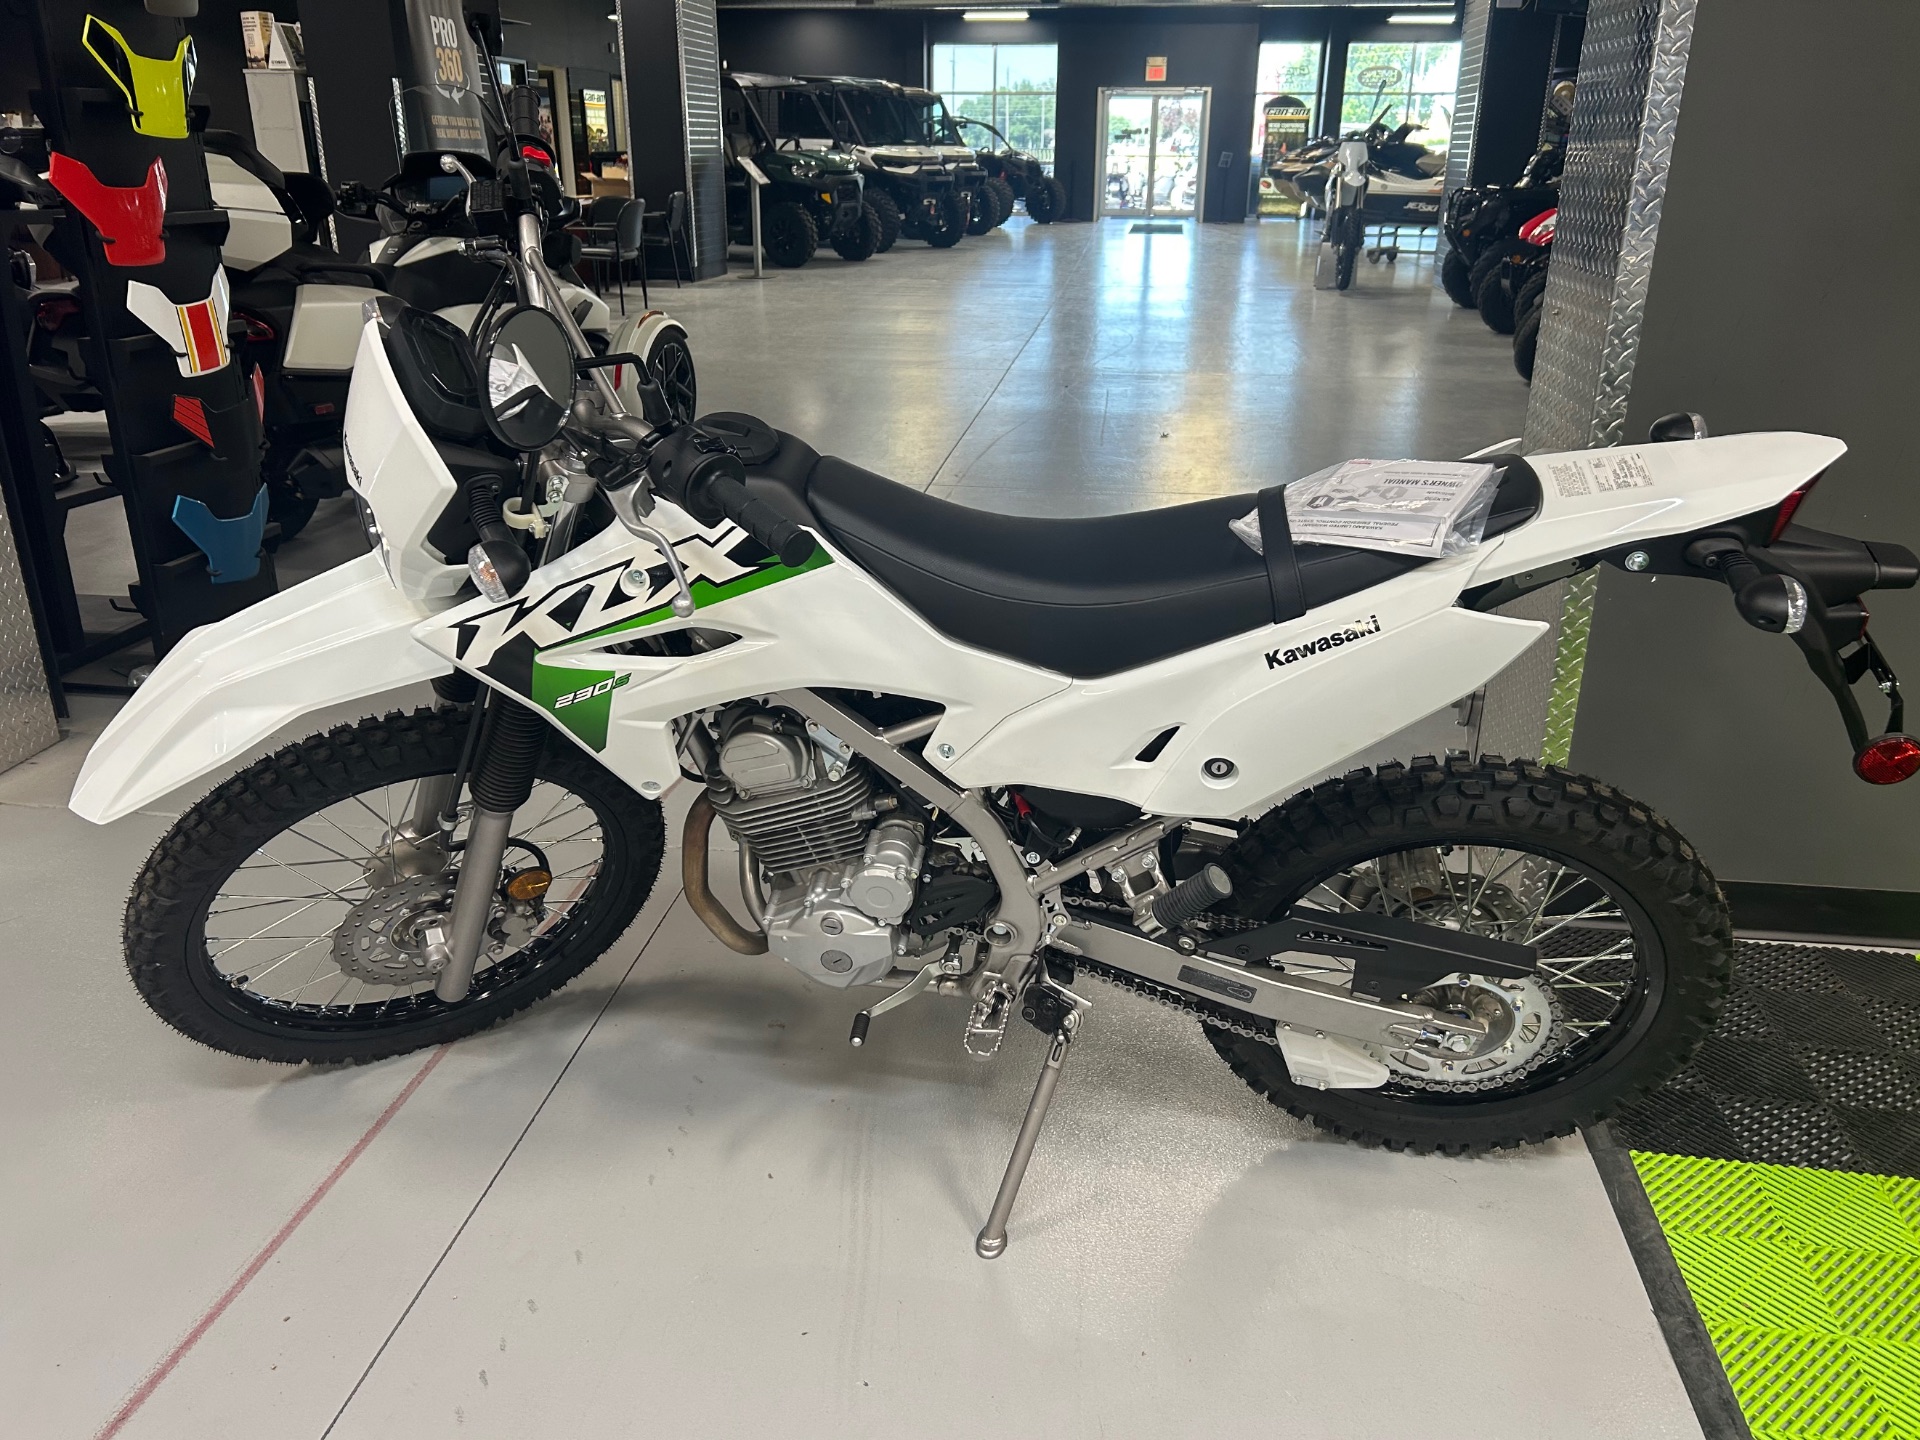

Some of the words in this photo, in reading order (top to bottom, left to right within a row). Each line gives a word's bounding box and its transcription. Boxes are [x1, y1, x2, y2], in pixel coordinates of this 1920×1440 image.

[430, 15, 458, 48] PRO
[447, 525, 762, 670] KLX
[1264, 614, 1381, 670] Kawasaki
